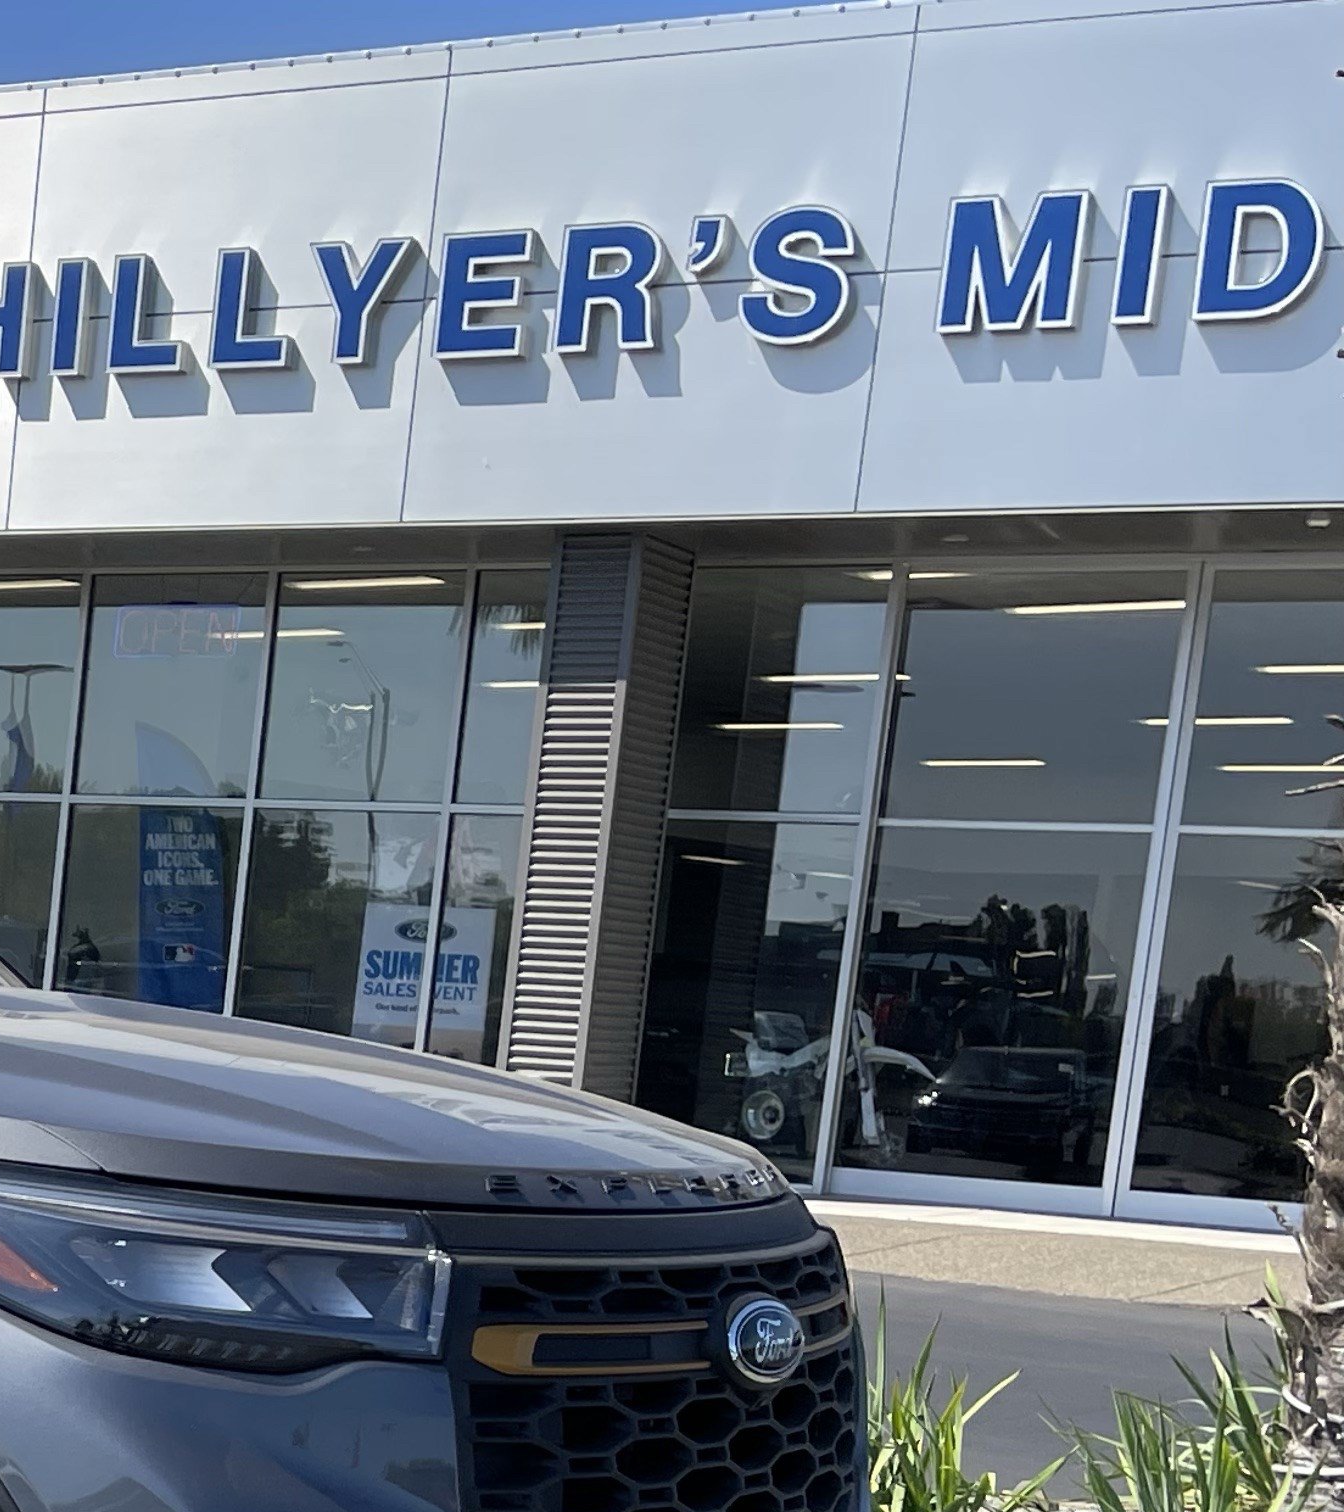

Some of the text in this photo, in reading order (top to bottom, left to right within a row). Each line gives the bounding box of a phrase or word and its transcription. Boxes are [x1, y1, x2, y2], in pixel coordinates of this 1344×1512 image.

[936, 177, 1324, 333] MID
[120, 608, 238, 655] OPEN
[168, 816, 194, 833] TWO
[145, 832, 217, 850] AMERICAN
[157, 850, 205, 868] ICONS.
[143, 868, 220, 886] ONE GAME.
[362, 981, 478, 1001] SALES VENT
[755, 1317, 794, 1363] Ford
